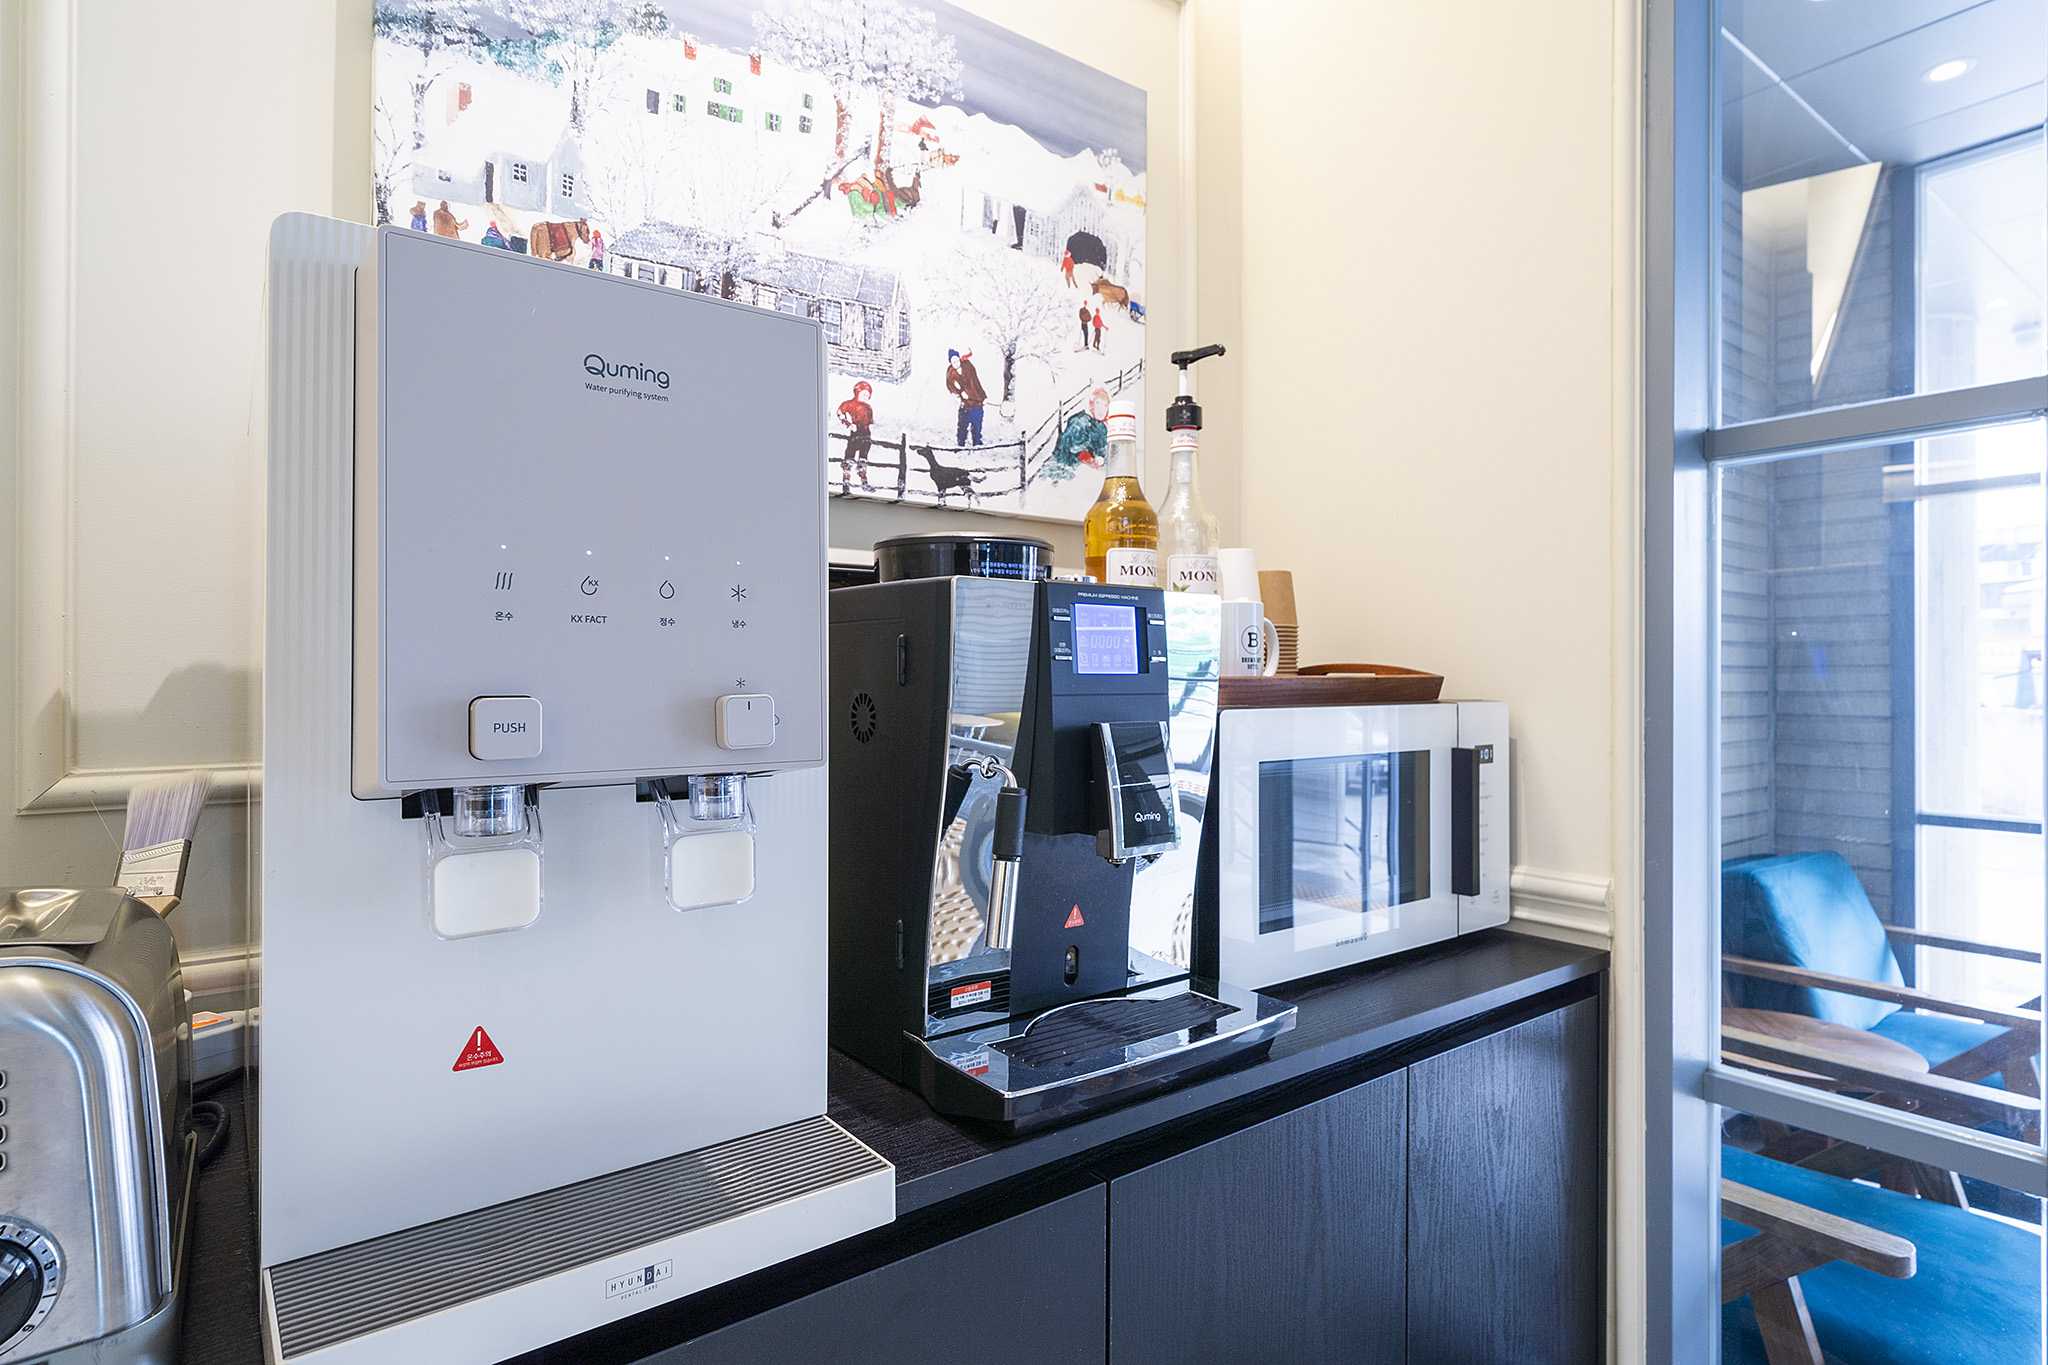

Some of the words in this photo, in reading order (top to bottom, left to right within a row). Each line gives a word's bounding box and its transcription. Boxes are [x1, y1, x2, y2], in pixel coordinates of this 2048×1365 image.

[583, 353, 670, 389] Quming
[585, 382, 607, 393] Water
[608, 386, 642, 400] purifying
[643, 392, 669, 402] system
[1120, 565, 1157, 577] MONI
[1179, 570, 1217, 582] MONI
[494, 610, 514, 621] 온수
[570, 614, 583, 623] KX
[584, 615, 607, 624] FACT
[659, 617, 676, 627] 정수
[731, 619, 747, 629] 냉수
[1247, 632, 1259, 648] B
[493, 722, 526, 733] PUSH
[1134, 811, 1161, 822] Quming
[466, 1050, 492, 1061] 온수주의
[611, 1266, 669, 1292] HYUNDAI
[620, 1290, 642, 1300] RENTAL
